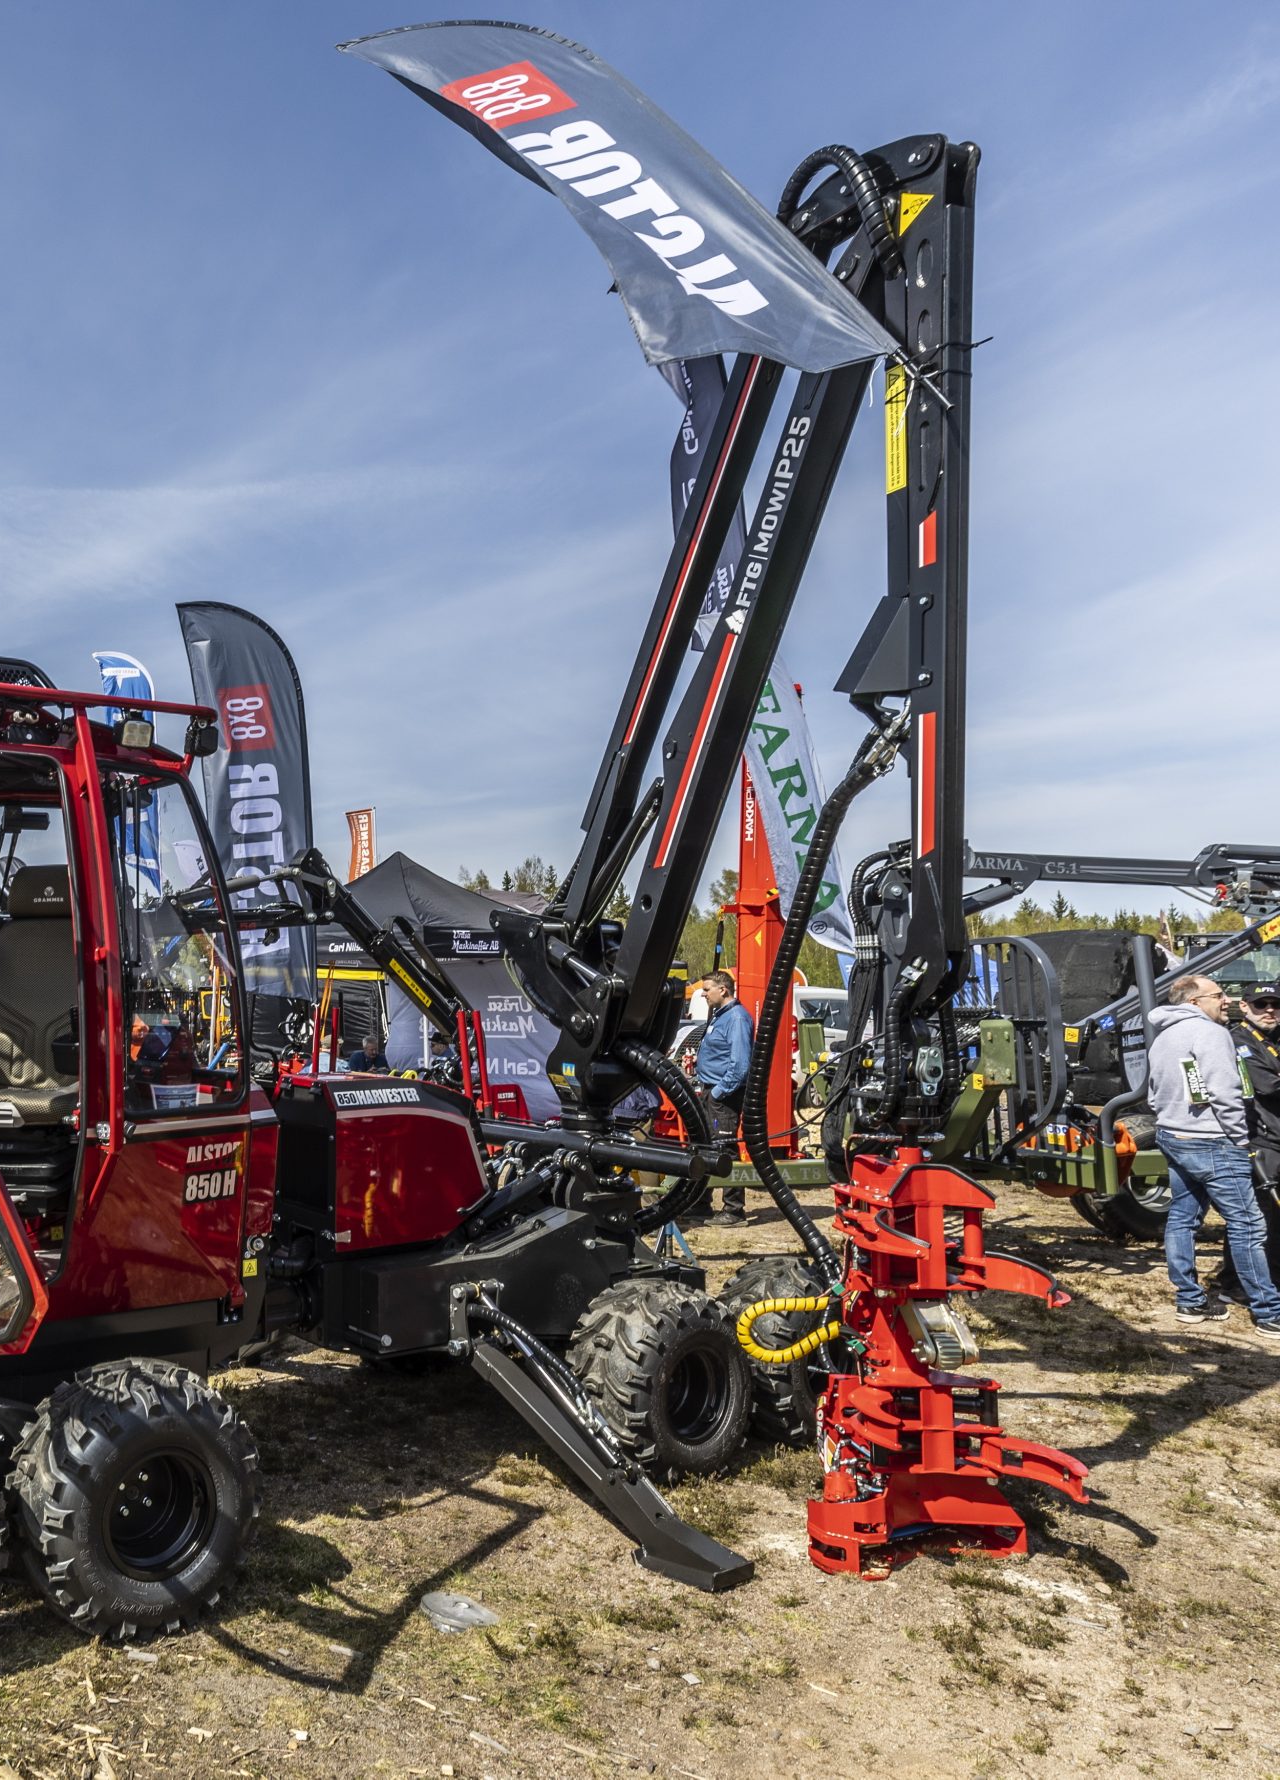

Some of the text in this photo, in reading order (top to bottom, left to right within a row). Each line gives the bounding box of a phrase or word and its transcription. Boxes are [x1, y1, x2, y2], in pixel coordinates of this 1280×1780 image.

[736, 562, 762, 608] FTG
[1045, 861, 1078, 875] C5.1
[328, 943, 345, 952] Carl
[489, 940, 500, 950] AB
[337, 1087, 420, 1105] 850 HARVESTER
[185, 1169, 237, 1202] 850 H
